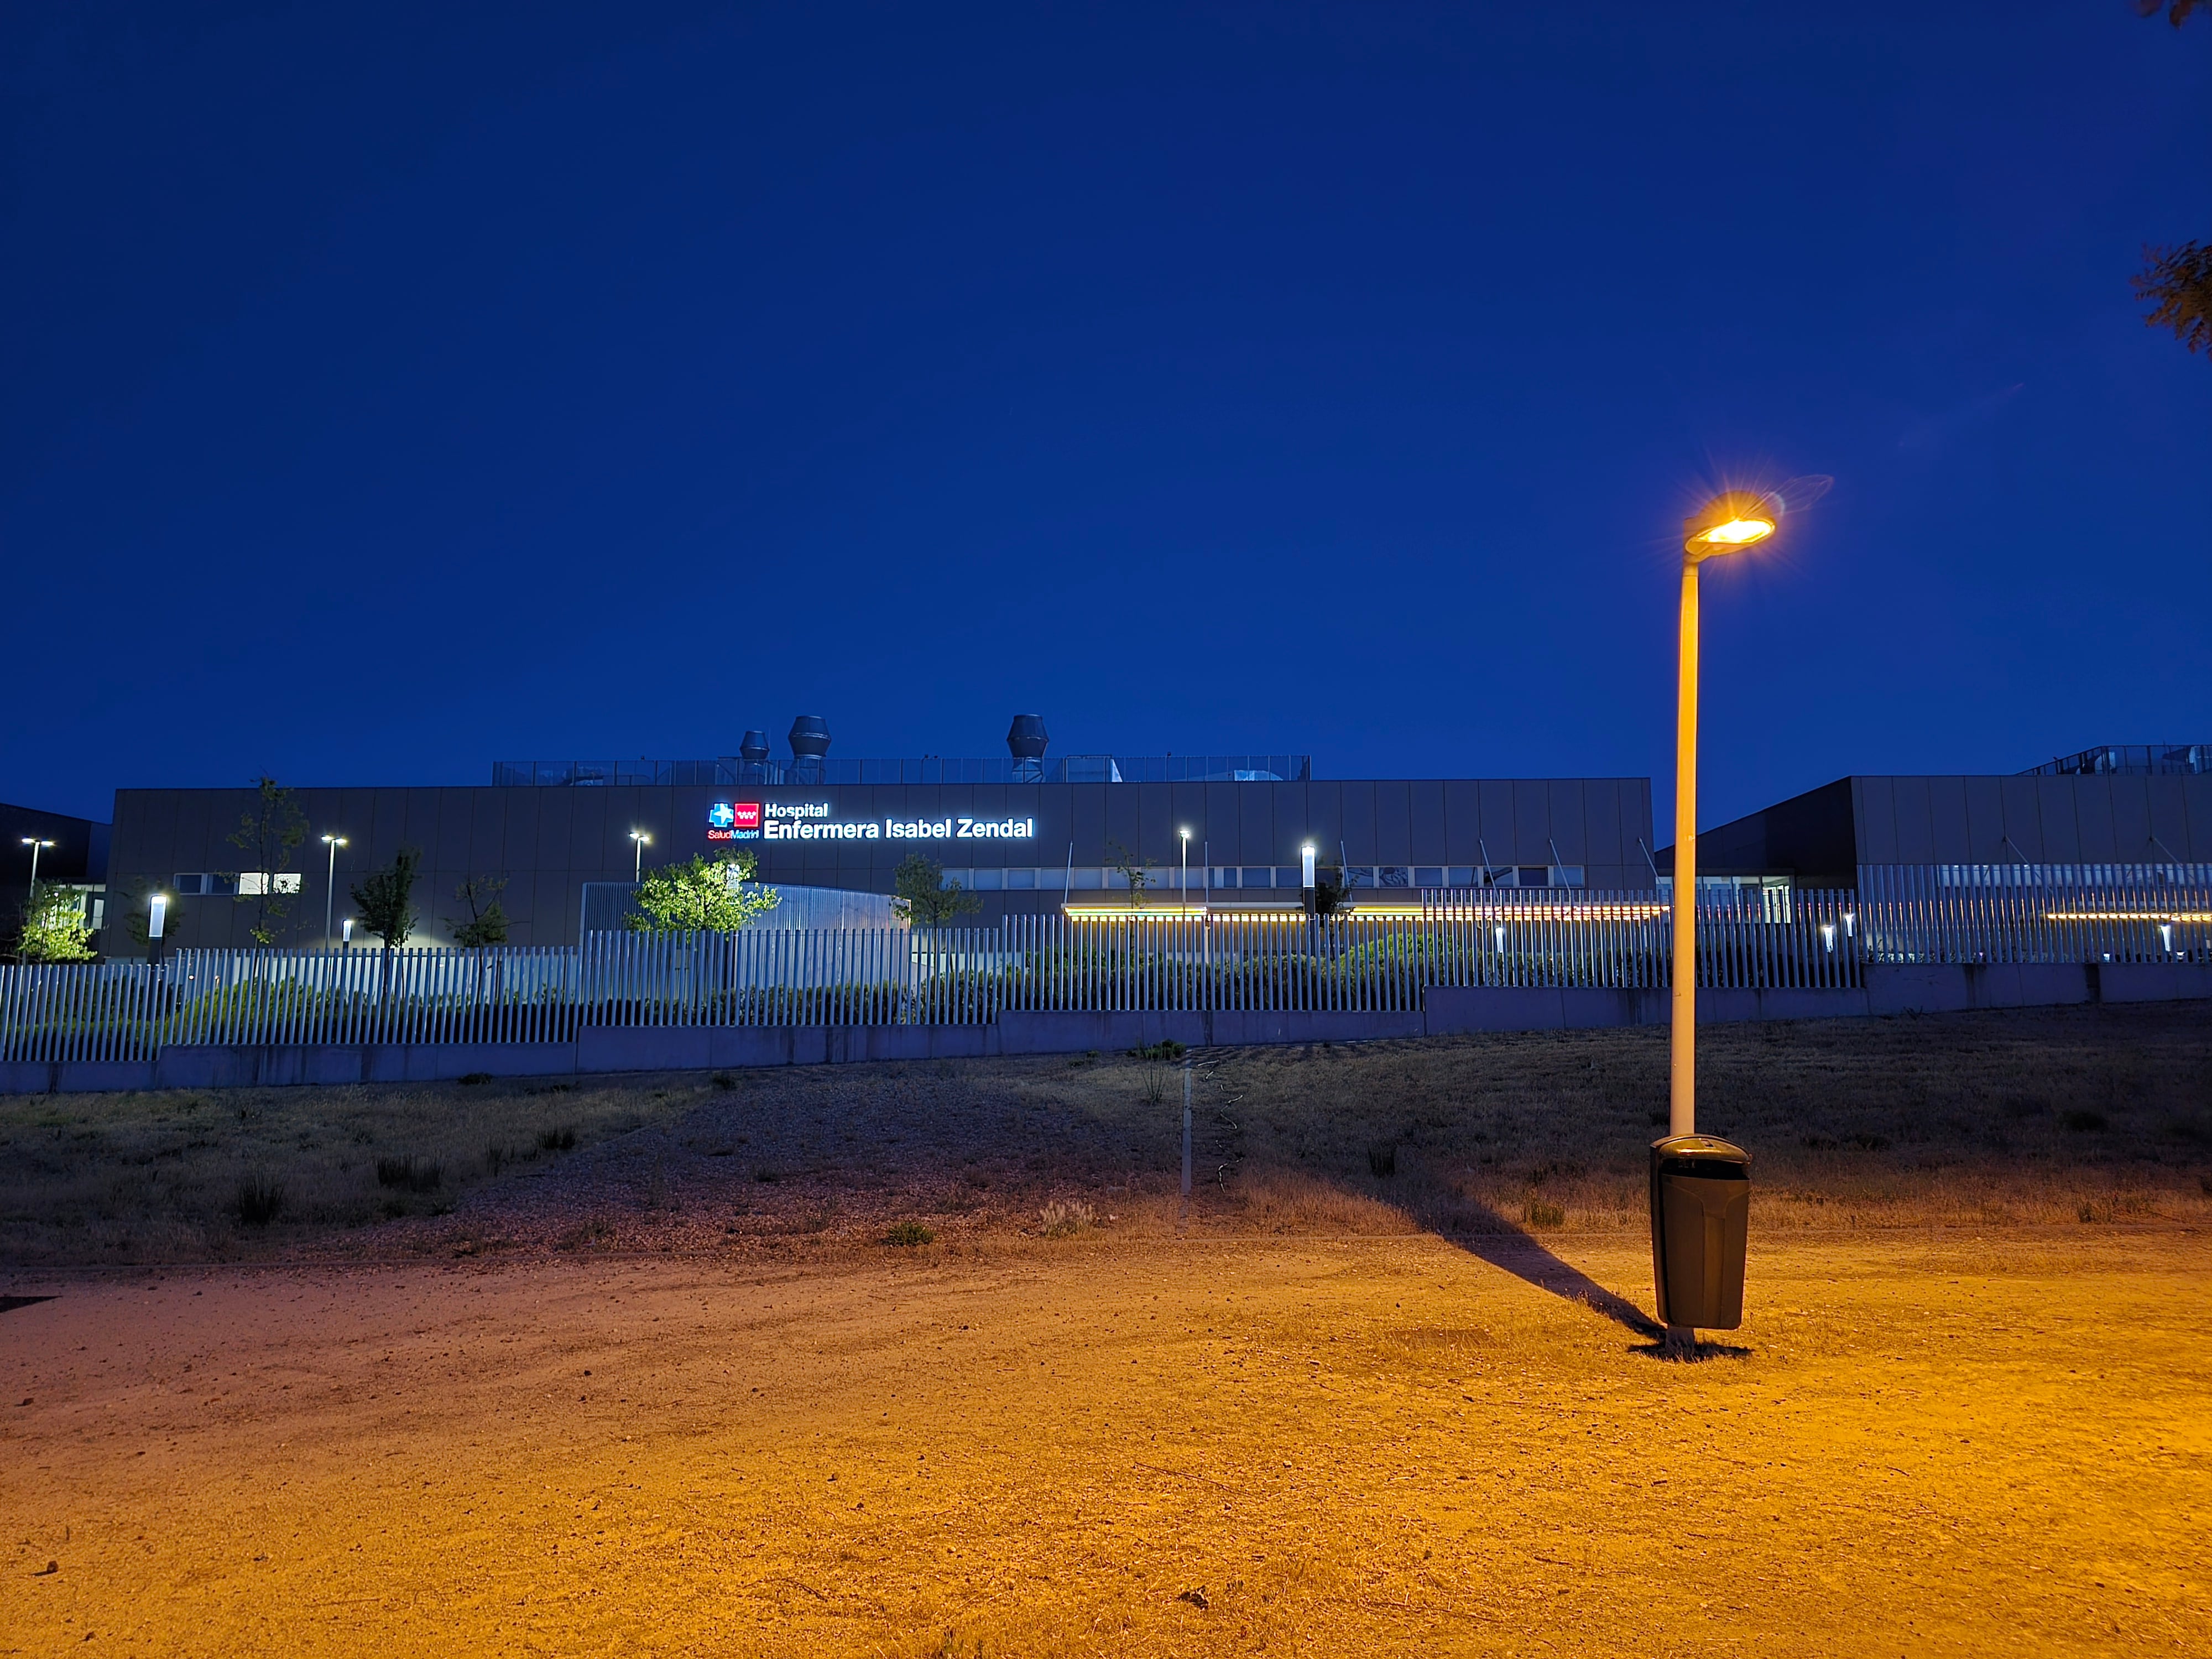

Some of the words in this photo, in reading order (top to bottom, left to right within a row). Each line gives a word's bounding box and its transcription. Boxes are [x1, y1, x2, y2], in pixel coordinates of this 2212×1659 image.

[765, 803, 828, 820] Hospital
[764, 820, 879, 839] Enfermera
[885, 818, 952, 839] Isabel
[956, 818, 1034, 838] Zendal
